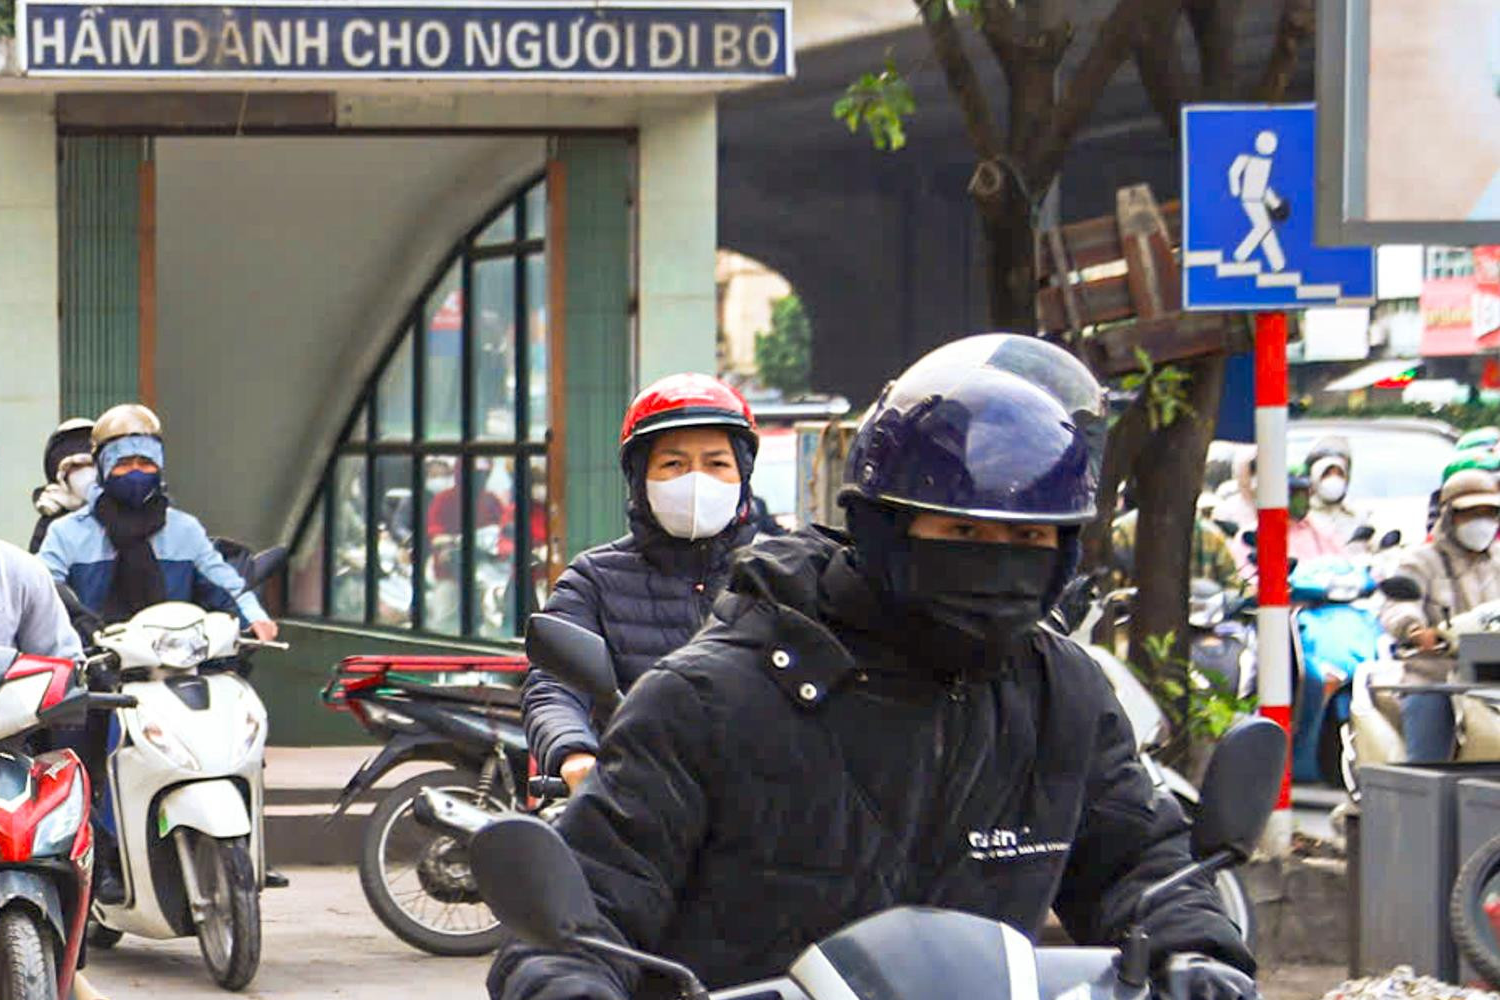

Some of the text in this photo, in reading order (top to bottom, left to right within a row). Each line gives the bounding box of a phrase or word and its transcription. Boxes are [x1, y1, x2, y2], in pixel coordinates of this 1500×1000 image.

[173, 8, 329, 66] DÀNH
[342, 19, 450, 67] CHO
[464, 9, 636, 68] NGƯỜI
